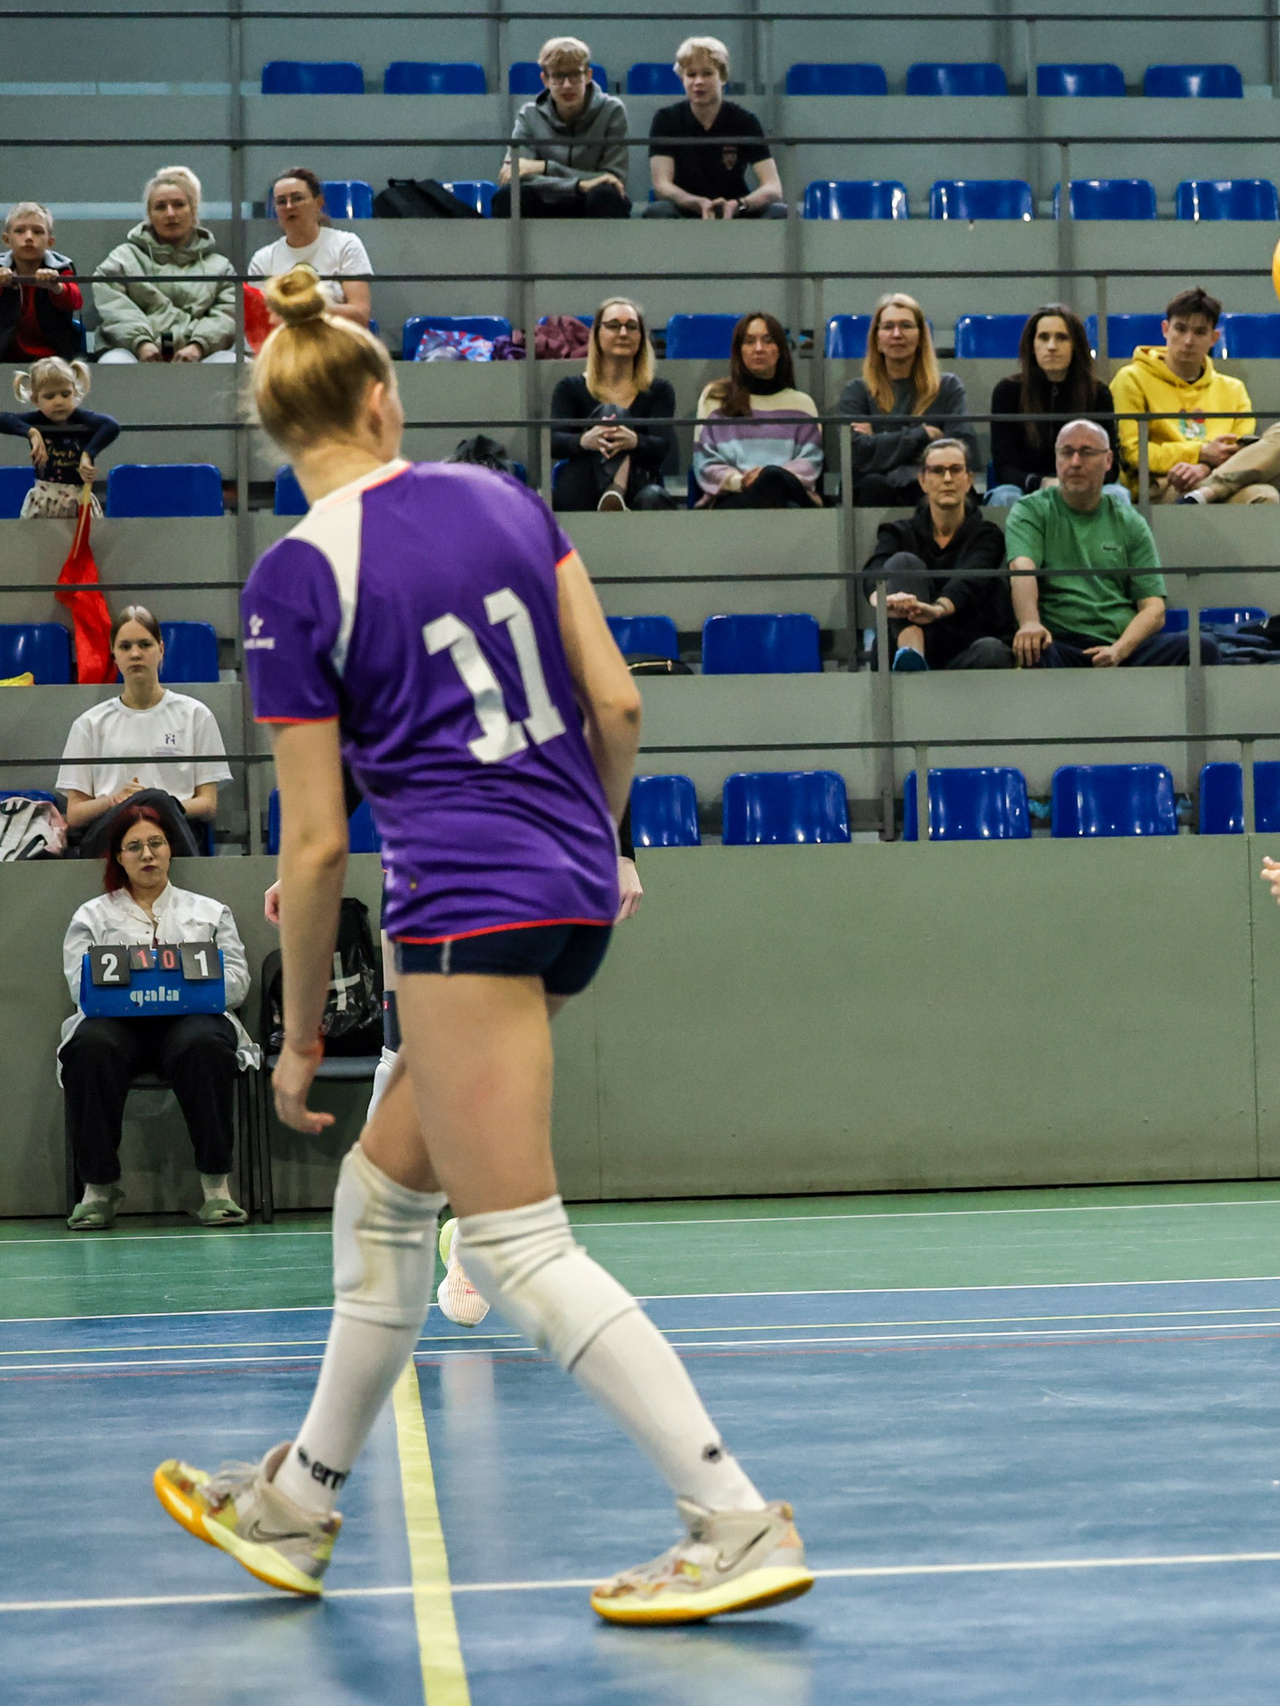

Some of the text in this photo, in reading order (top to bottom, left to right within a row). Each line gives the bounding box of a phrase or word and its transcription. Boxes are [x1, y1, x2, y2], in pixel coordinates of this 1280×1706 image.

[422, 587, 567, 764] 11
[101, 950, 209, 982] 2 1 0 1
[130, 986, 180, 1008] gala
